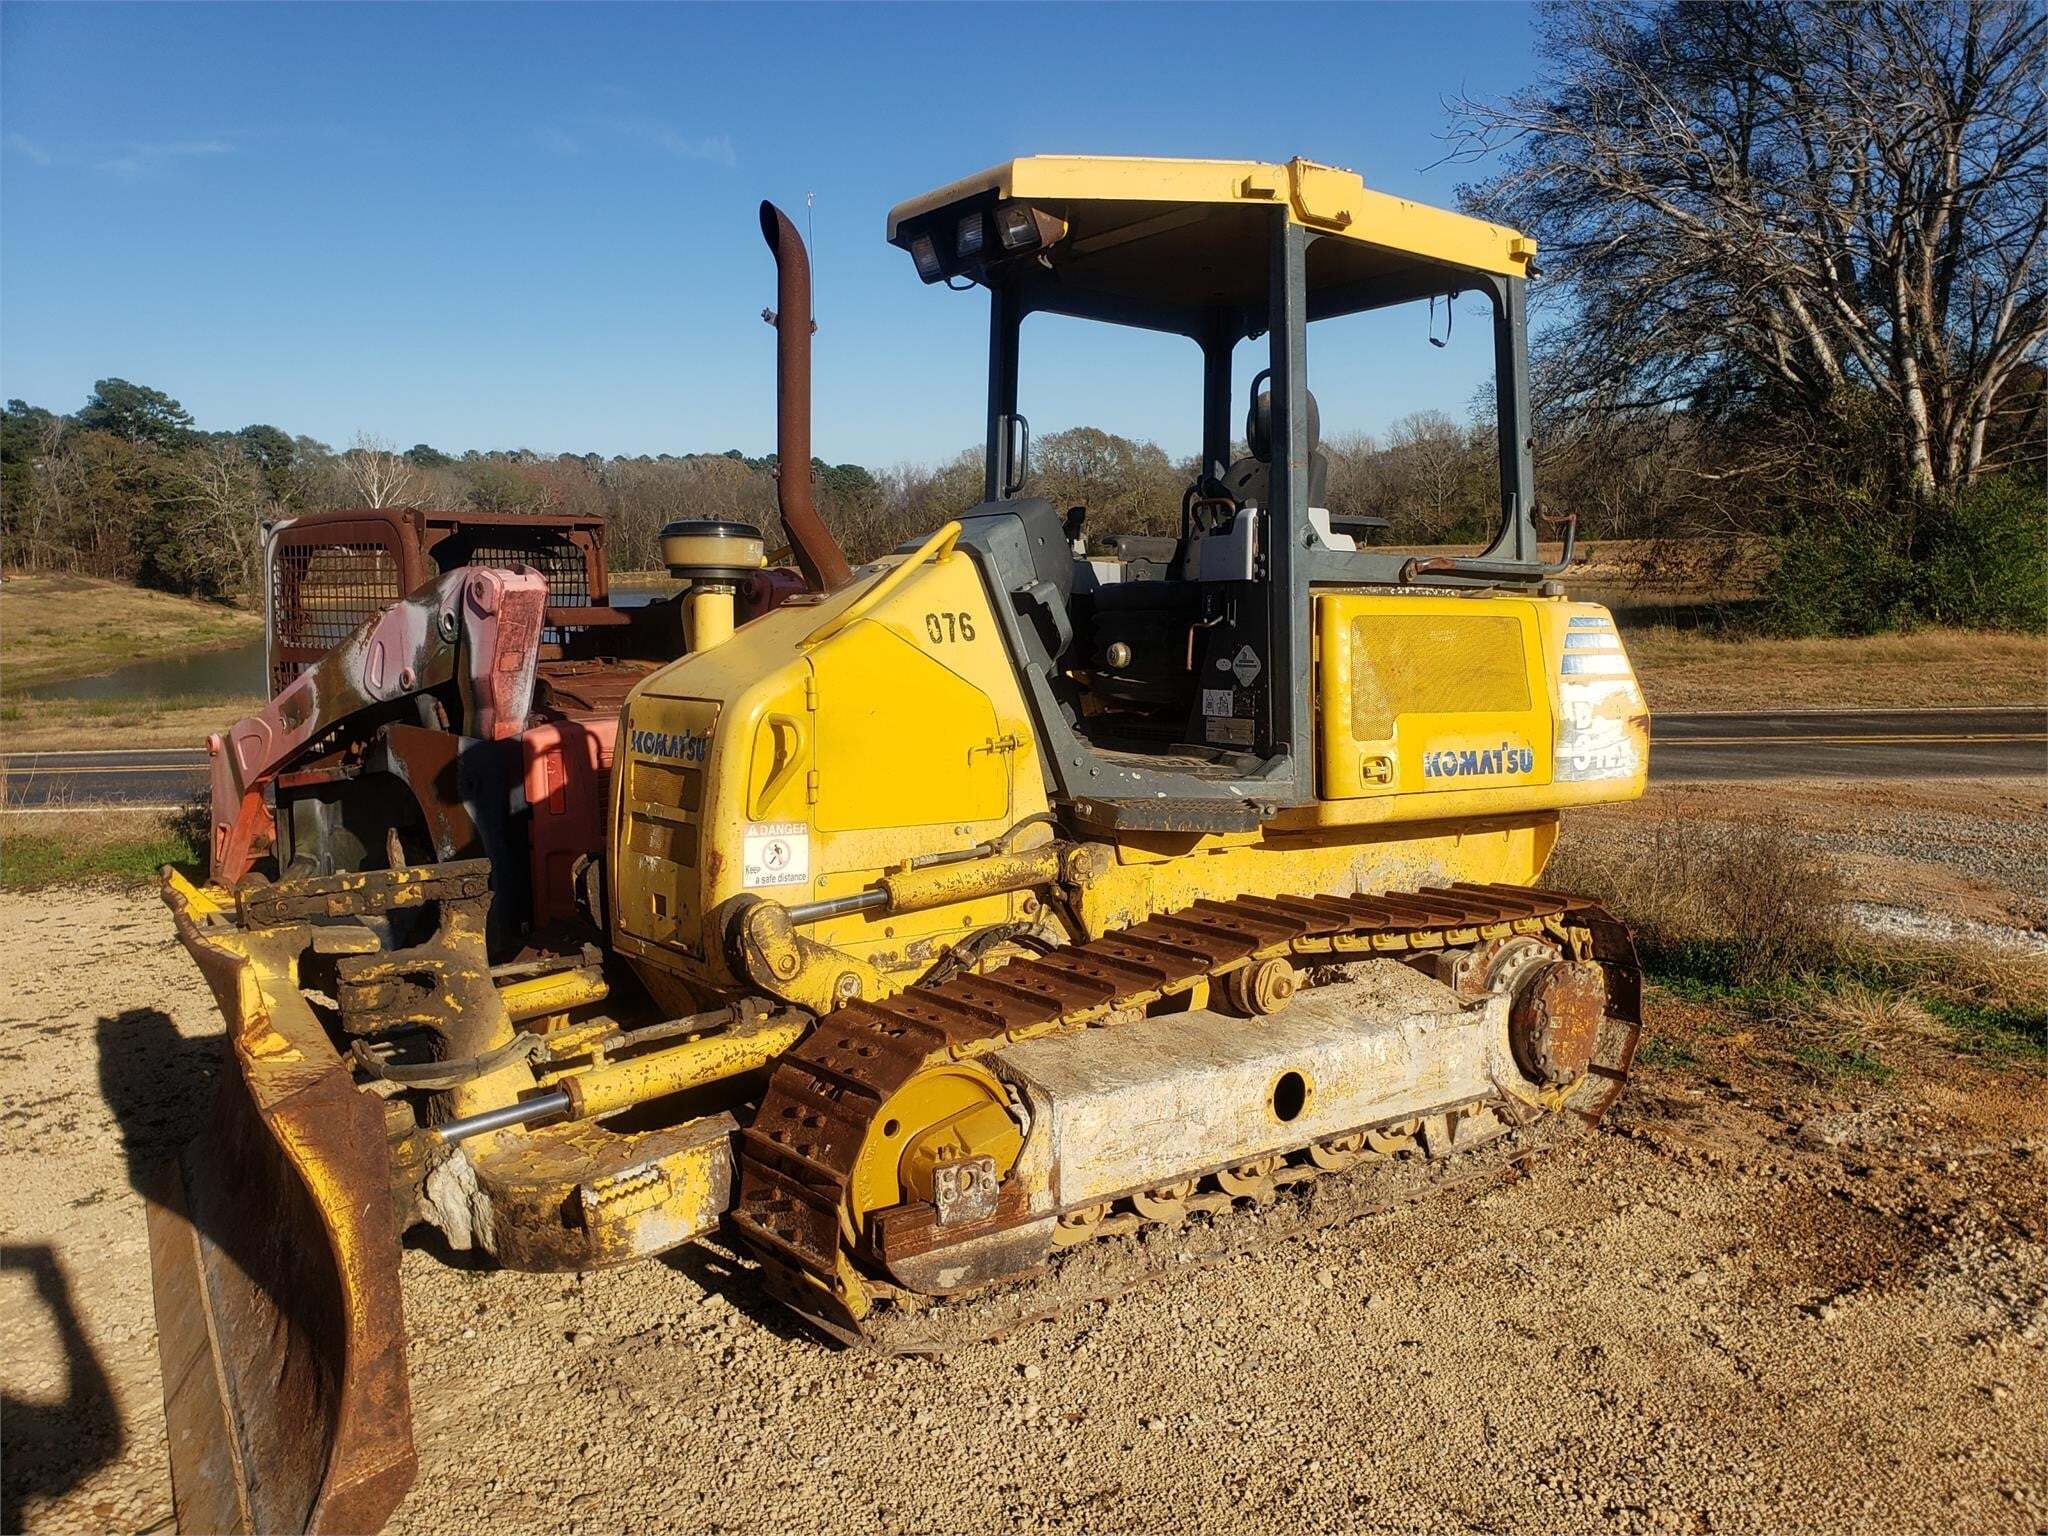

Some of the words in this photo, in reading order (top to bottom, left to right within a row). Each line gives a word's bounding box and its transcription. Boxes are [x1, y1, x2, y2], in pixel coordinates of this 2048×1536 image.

[925, 612, 976, 644] 076
[631, 729, 706, 762] KOMATSU
[1424, 741, 1533, 778] KOMATSU
[760, 823, 807, 836] DANGER
[745, 865, 761, 876] Keep
[761, 874, 777, 884] safe
[777, 872, 807, 883] distance
